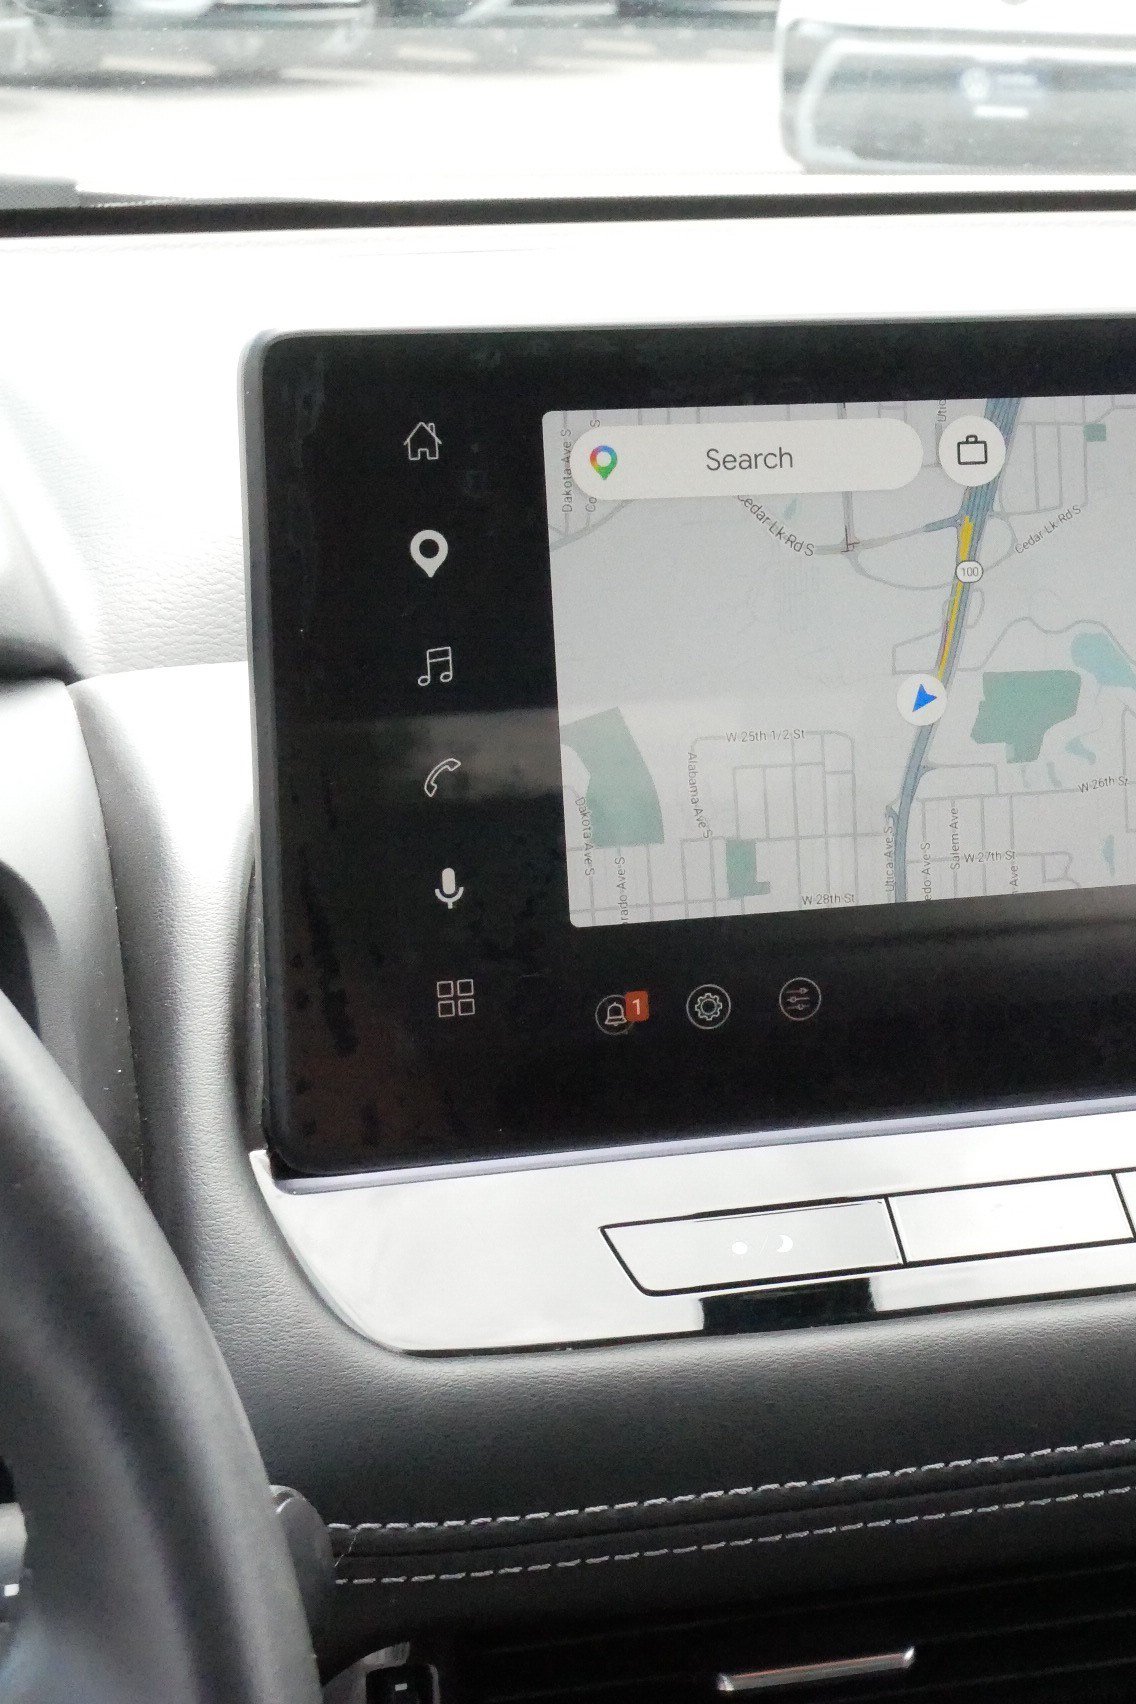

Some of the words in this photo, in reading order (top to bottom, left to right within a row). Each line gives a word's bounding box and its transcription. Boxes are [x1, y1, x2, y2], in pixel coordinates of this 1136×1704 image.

[560, 428, 572, 437] S
[561, 441, 572, 464] Ave
[705, 446, 794, 472] Search
[561, 468, 573, 513] Dakota
[769, 521, 786, 540] Lk
[785, 533, 804, 552] Rd
[804, 543, 815, 557] S
[1015, 531, 1043, 554] Cedar
[1044, 521, 1058, 534] Lk
[1058, 509, 1074, 523] Rd
[1072, 504, 1082, 514] S
[962, 566, 979, 577] 100
[725, 731, 737, 742] W
[741, 731, 767, 743] 25th
[793, 728, 806, 740] St
[687, 752, 700, 805] Alabama
[1077, 782, 1089, 793] W
[1092, 776, 1115, 790] 26th
[1118, 775, 1128, 787] St
[574, 796, 592, 839] Dakota
[693, 808, 706, 829] Ave
[949, 807, 959, 829] Ave
[703, 829, 713, 839] S
[884, 826, 893, 834] S
[584, 842, 594, 866] Ave
[884, 836, 894, 858] Ave
[920, 842, 931, 850] S
[950, 833, 960, 870] Salem
[963, 852, 975, 863] W
[978, 851, 1002, 863] 27th
[1005, 849, 1016, 861] St
[614, 856, 625, 865] S
[921, 855, 931, 876] Ave
[584, 867, 595, 876] S
[616, 869, 626, 890] Ave
[884, 862, 895, 893] Utica
[1009, 865, 1019, 887] Ave
[801, 894, 813, 905] W
[816, 893, 841, 904] 28th
[844, 893, 856, 904] St
